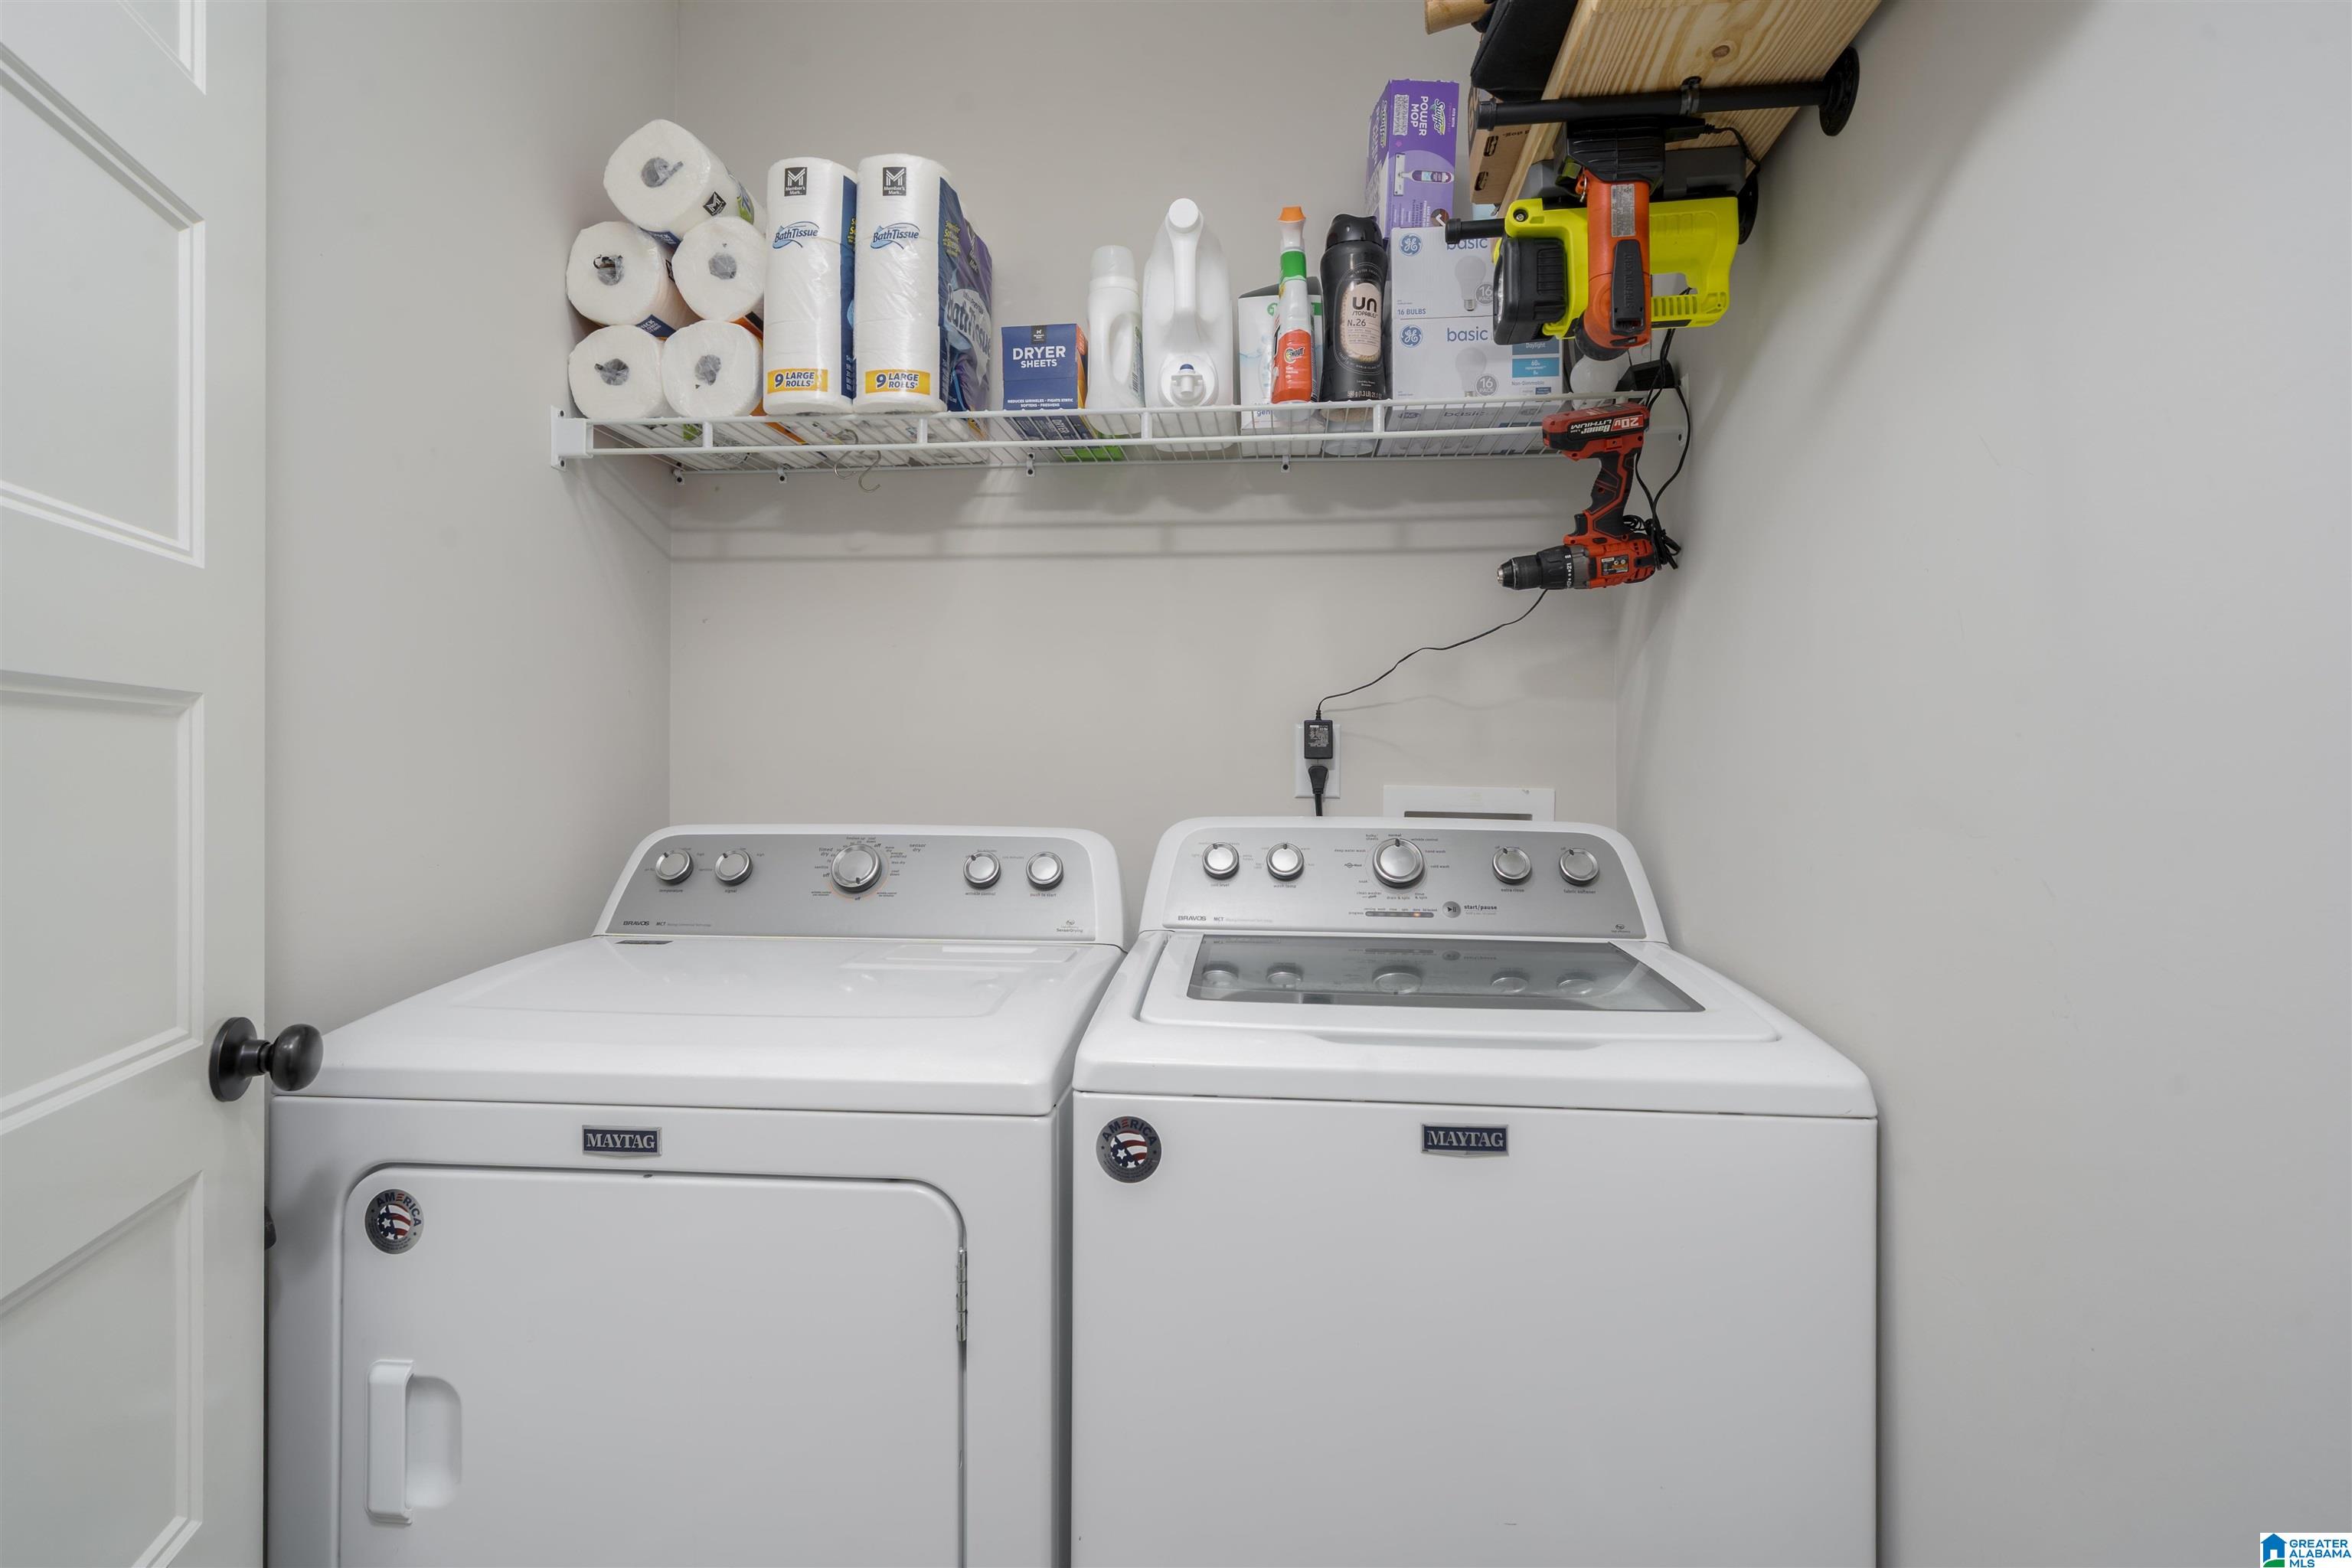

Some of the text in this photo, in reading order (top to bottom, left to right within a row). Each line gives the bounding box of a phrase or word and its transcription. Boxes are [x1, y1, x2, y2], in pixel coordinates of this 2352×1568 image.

[1410, 103, 1419, 128] MOP
[1419, 96, 1429, 136] POWER
[1432, 99, 1446, 135] Swiffer
[775, 228, 818, 243] BathTissue
[873, 229, 919, 243] BathTissue
[1478, 286, 1493, 296] 16
[1347, 318, 1367, 327] N.26
[1447, 326, 1488, 341] basic
[1013, 345, 1066, 361] DRYER
[1021, 359, 1057, 368] SHEETS
[775, 374, 784, 387] 9
[876, 372, 919, 388] 9 LARGE
[1481, 377, 1493, 388] 16
[1571, 419, 1612, 430] LITHIUM
[1581, 424, 1611, 434] Bauer
[1102, 1119, 1157, 1146] AMERICA
[1427, 1131, 1504, 1147] MAYTAG
[586, 1133, 655, 1148] MAYTAG
[377, 1192, 422, 1227] AMERICA
